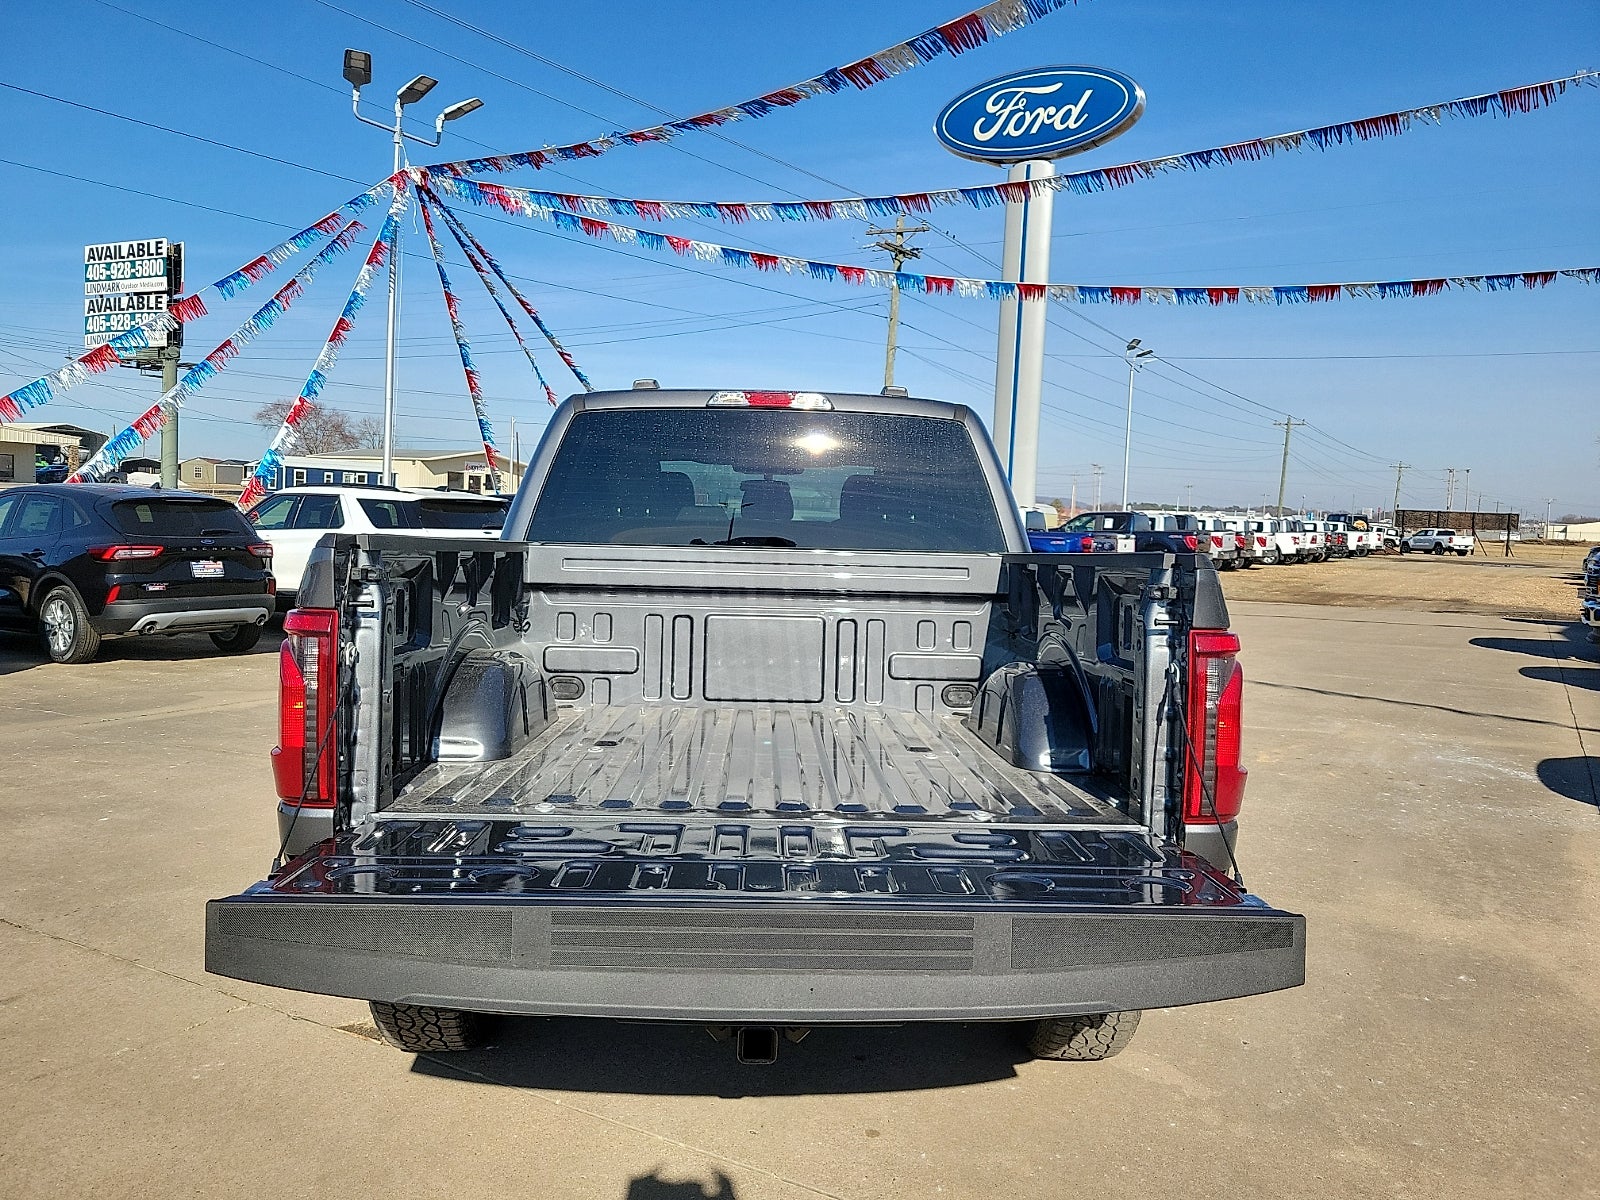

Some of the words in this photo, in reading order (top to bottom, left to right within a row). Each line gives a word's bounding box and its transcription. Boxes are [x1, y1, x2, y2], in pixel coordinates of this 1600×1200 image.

[973, 81, 1093, 142] Ford
[87, 240, 163, 262] AVAILABLE
[86, 259, 163, 280] 405-928-5800
[86, 281, 121, 294] LINDMARK
[87, 295, 163, 314] AVAILABLE
